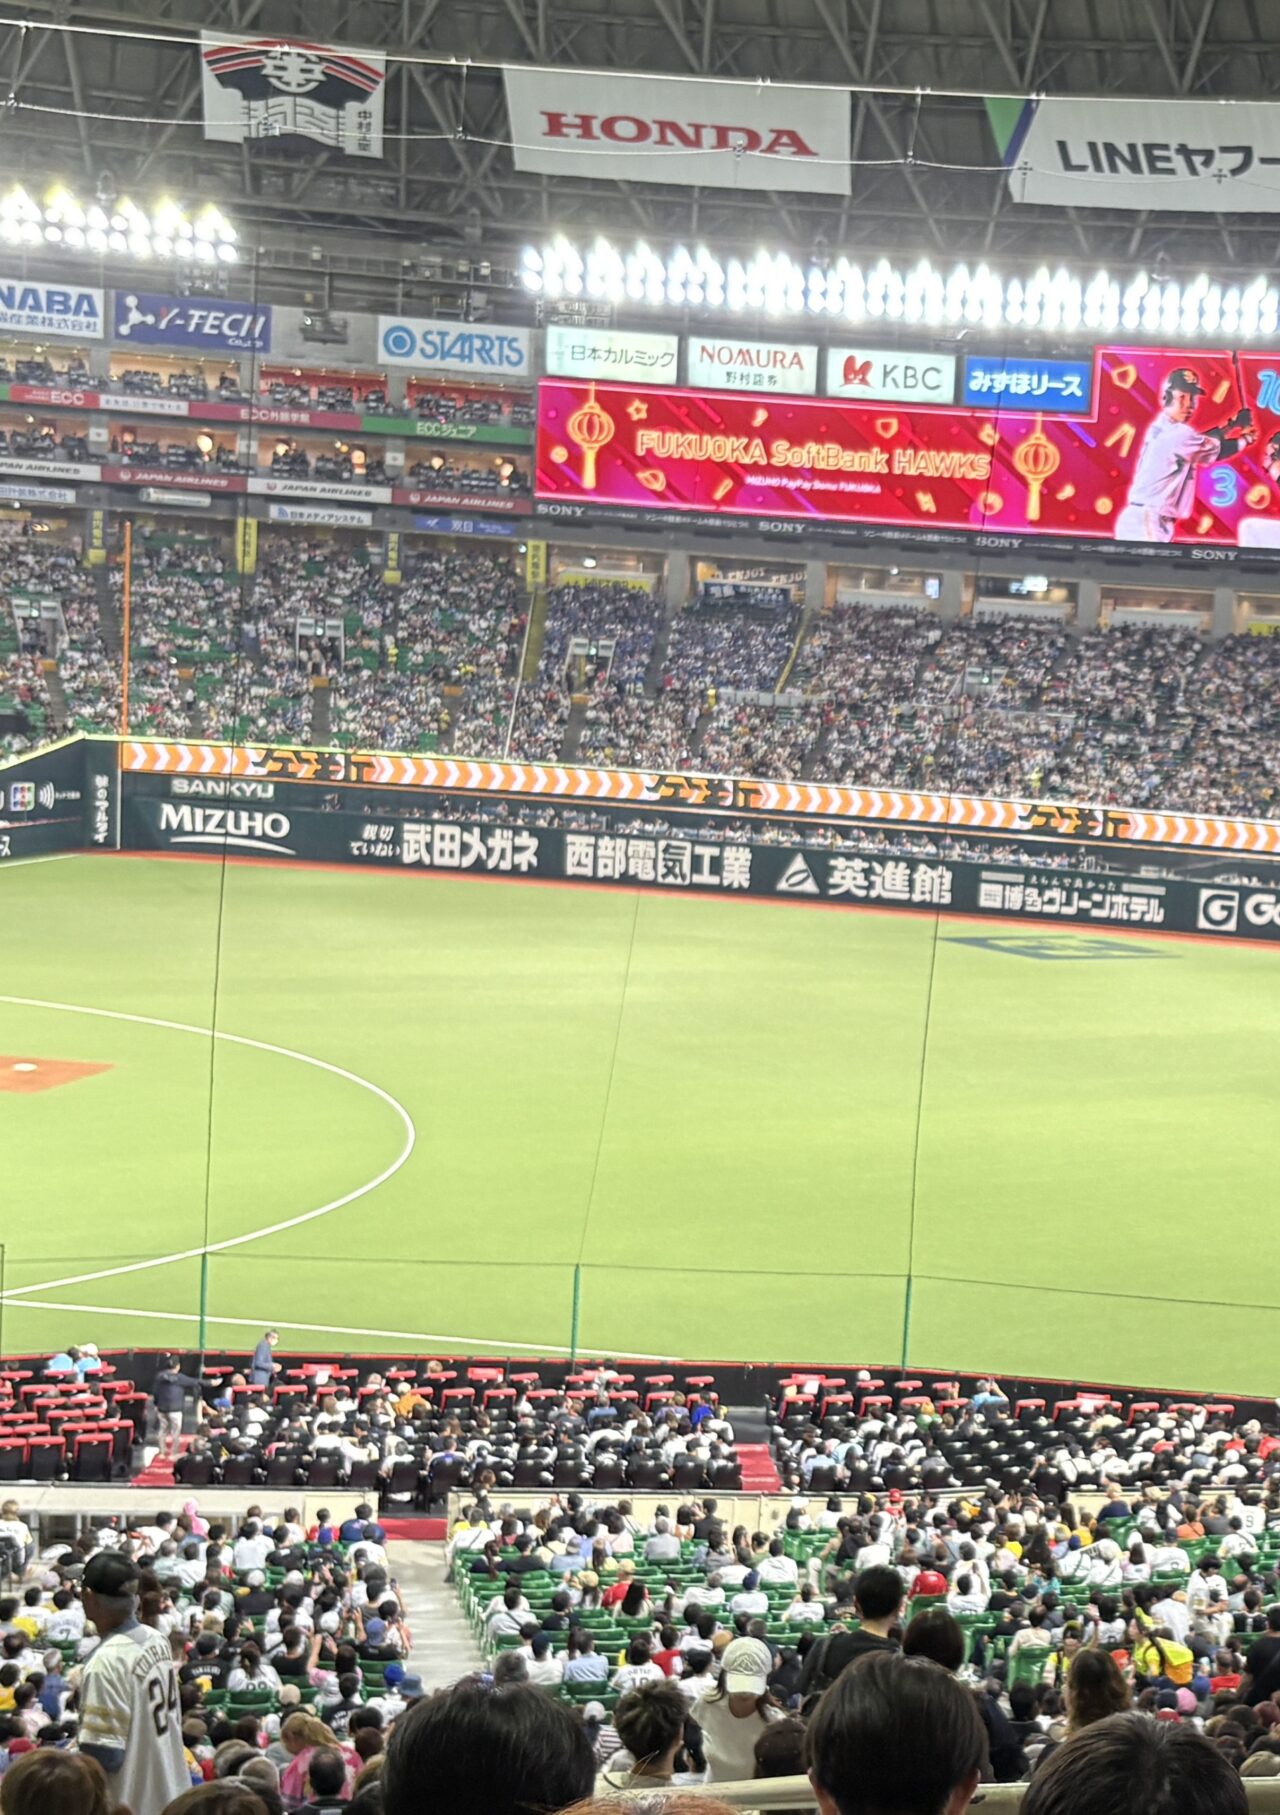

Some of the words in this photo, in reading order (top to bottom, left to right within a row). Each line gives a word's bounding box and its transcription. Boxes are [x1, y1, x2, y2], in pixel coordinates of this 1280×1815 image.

[540, 111, 819, 156] HONDA
[420, 332, 525, 369] STARTS
[571, 345, 675, 368] 日本カルミック
[700, 345, 805, 370] NOMURA
[882, 364, 942, 390] KBC
[969, 370, 1082, 397] みずほリース
[51, 391, 85, 405] ECC
[416, 422, 477, 438] ECCジュニア
[636, 429, 767, 465] FUKUOKA
[771, 440, 889, 473] SoftBank
[893, 449, 992, 480] HAWKS
[25, 463, 80, 475] AIRLINES
[135, 471, 173, 483] JAPAN
[175, 475, 229, 487] AIRLINES
[282, 483, 318, 494] JAPAN
[319, 487, 372, 498] AIRLINES
[1210, 464, 1238, 507] 3
[424, 494, 460, 505] JAPAN
[461, 498, 514, 509] AIRLINES
[536, 503, 585, 517] SONY
[758, 520, 806, 533] SONY
[975, 536, 1022, 548] SONY
[1191, 549, 1238, 561] SONY
[171, 778, 274, 799] SANKYU
[160, 803, 290, 838] MIZUHO
[349, 840, 400, 858] ていねい
[402, 823, 540, 872] 武田メガネ
[565, 834, 752, 889] 西部電気工業
[827, 857, 952, 904] 英進館
[1004, 884, 1165, 923] 博多グリーンホテル
[149, 1669, 179, 1736] 24
